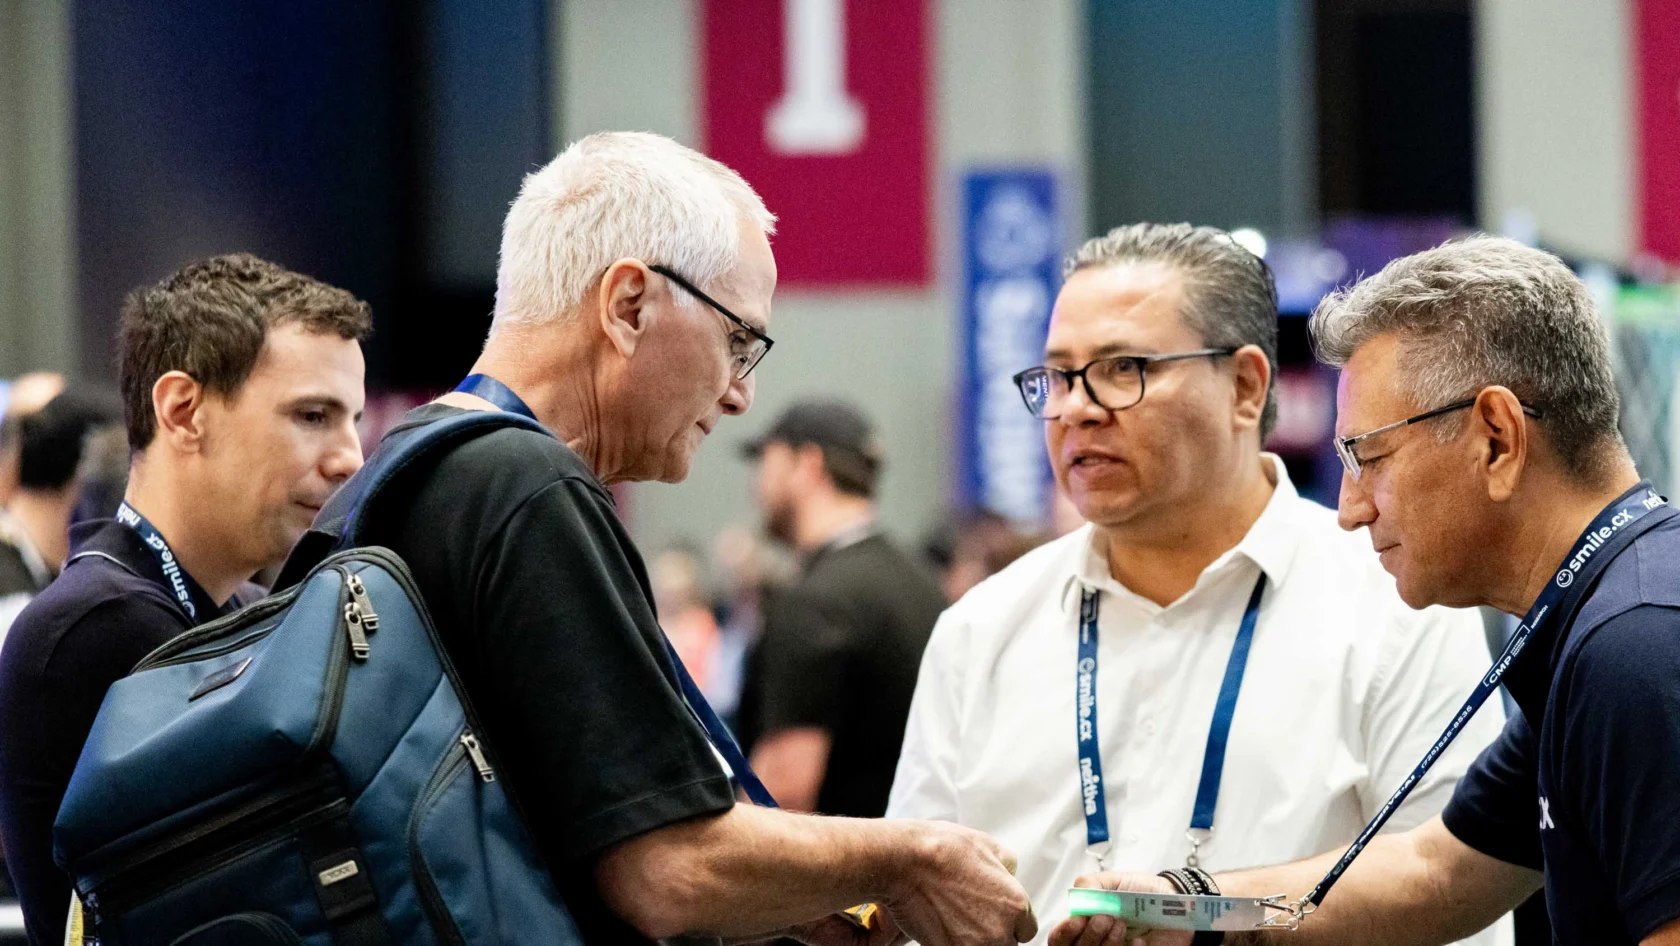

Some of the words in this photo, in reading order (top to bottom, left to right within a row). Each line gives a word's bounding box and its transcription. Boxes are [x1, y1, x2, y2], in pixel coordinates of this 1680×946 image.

[146, 532, 189, 602] smile.cx
[1569, 508, 1634, 572] smile.cx
[1489, 655, 1512, 684] CMP
[1079, 673, 1095, 743] smile.cx
[1080, 756, 1101, 816] nextiva
